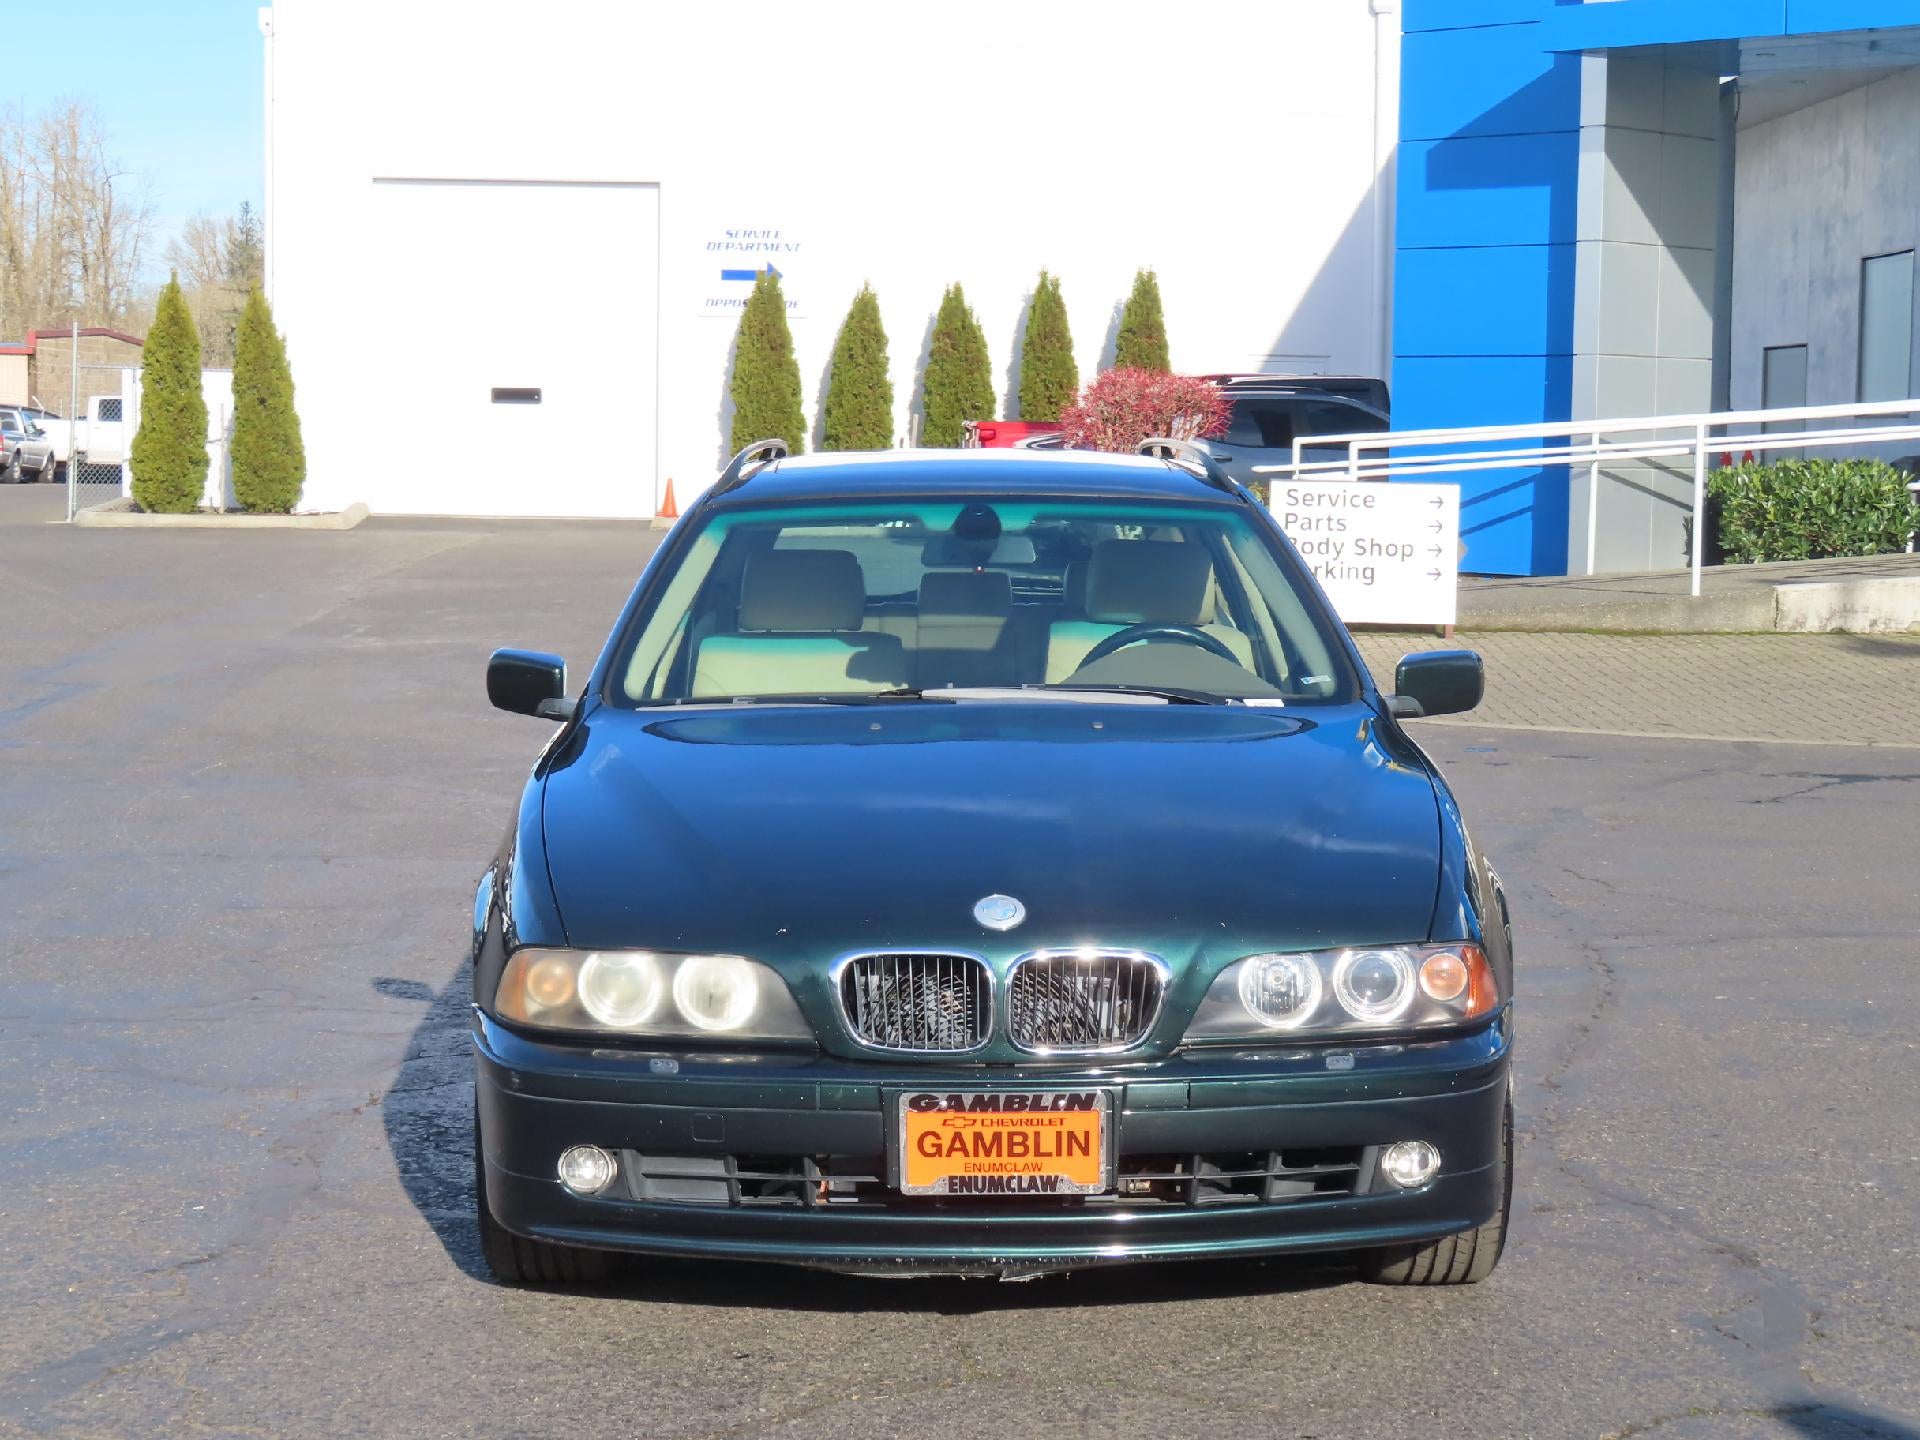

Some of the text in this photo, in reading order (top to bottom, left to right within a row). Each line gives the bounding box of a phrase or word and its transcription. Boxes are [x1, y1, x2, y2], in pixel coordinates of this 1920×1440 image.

[725, 229, 782, 239] SERVICE
[706, 241, 801, 252] DEPARTMENT
[1286, 488, 1376, 508] Service
[1284, 512, 1347, 532] Parts
[1354, 537, 1415, 562] Shop
[1312, 561, 1376, 586] rking
[908, 1093, 1098, 1113] GAMBLIN
[980, 1117, 1069, 1128] CHEVROLET
[916, 1130, 1091, 1159] GAMBLIN
[964, 1161, 1043, 1173] ENUMCLAW
[948, 1174, 1061, 1194] ENUMCLAW
